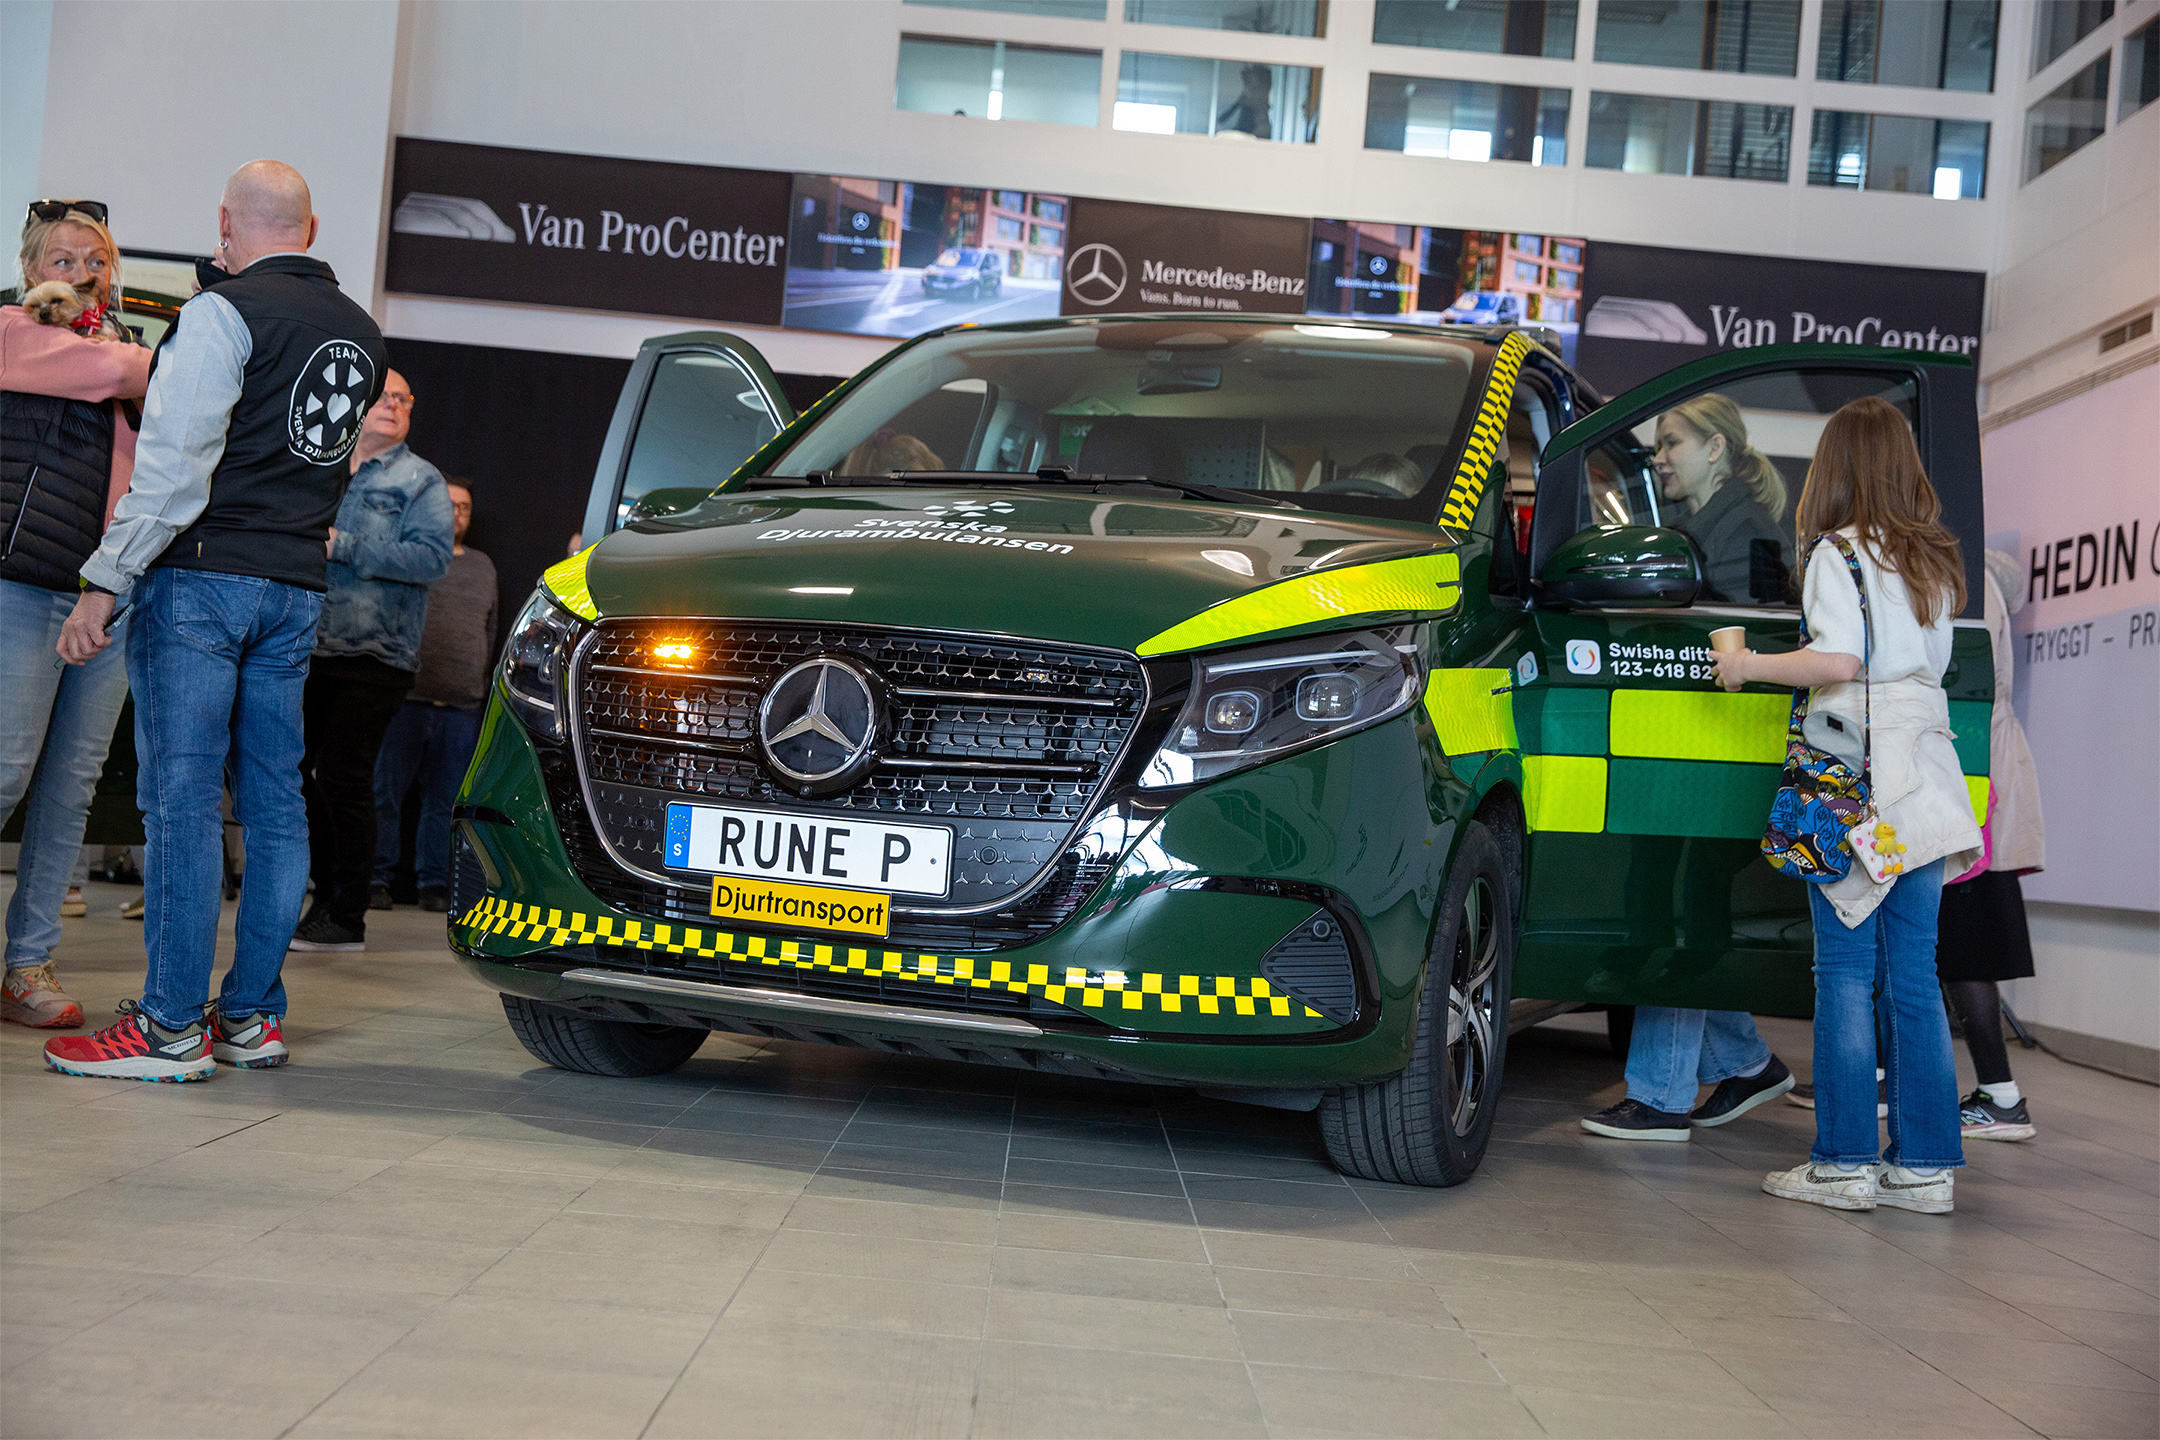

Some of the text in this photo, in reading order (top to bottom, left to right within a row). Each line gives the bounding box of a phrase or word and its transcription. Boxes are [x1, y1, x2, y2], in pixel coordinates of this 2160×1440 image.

[517, 202, 586, 251] Van
[597, 210, 785, 268] ProCenter
[1140, 259, 1305, 296] Mercedes-Benz
[1139, 288, 1242, 311] Vans. Born to run.
[1709, 304, 1979, 355] Van ProCenter
[328, 346, 359, 363] TEAM
[756, 528, 1075, 555] Djurambulansen
[854, 518, 1008, 533] Svenska
[2029, 520, 2140, 602] HEDIN
[1608, 642, 1714, 662] Swisha ditt
[2024, 622, 2095, 665] TRYGGT
[1610, 660, 1685, 679] 123-618
[673, 843, 683, 857] S
[718, 816, 912, 883] RUNE P
[715, 885, 884, 927] Djurtransport
